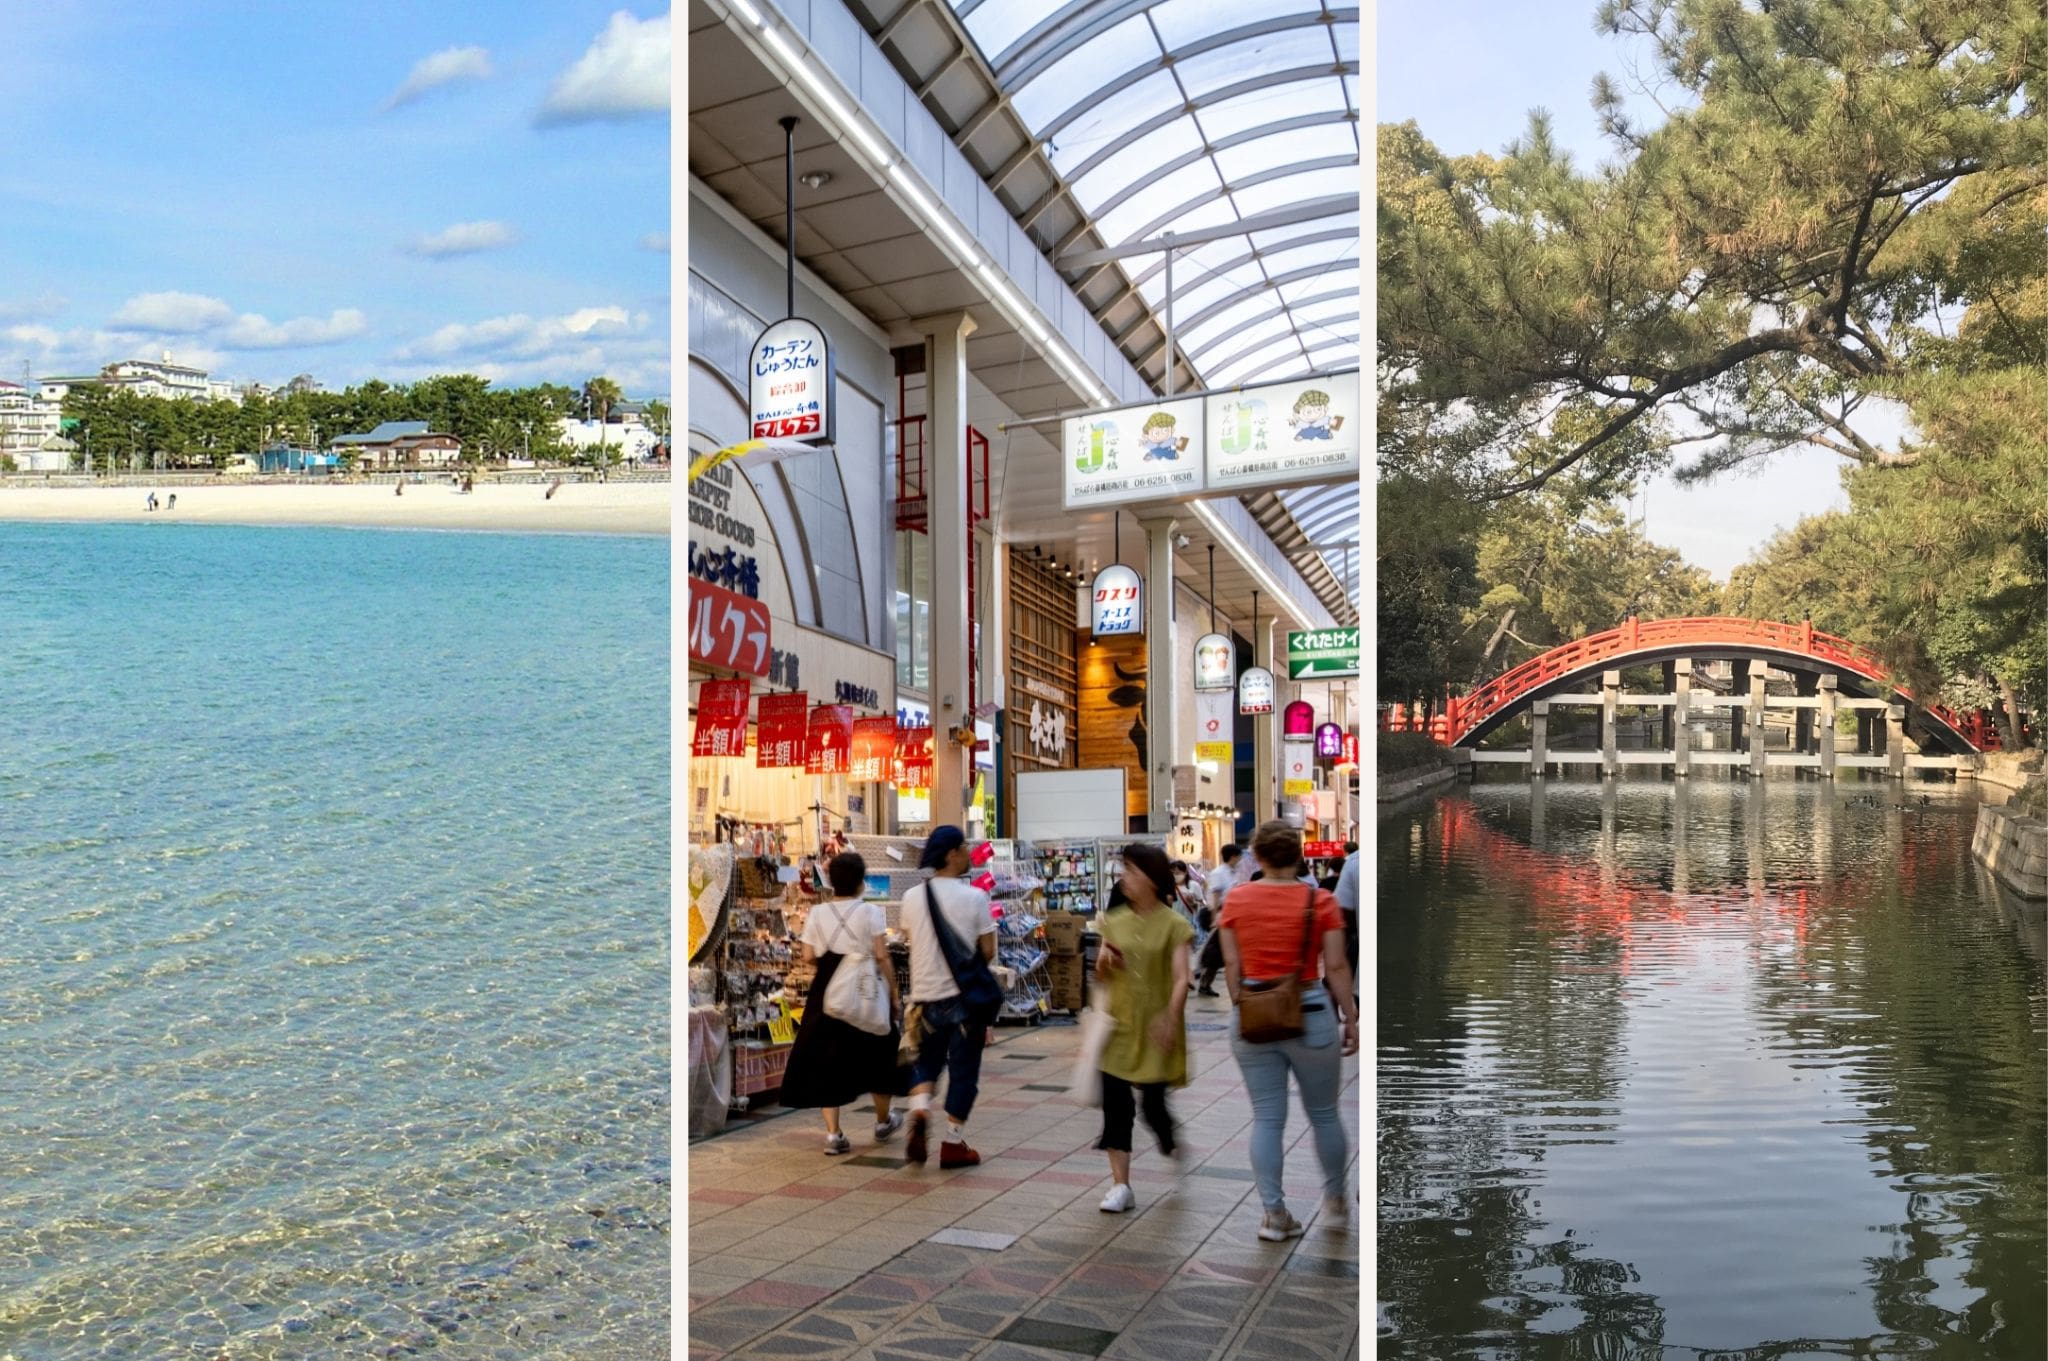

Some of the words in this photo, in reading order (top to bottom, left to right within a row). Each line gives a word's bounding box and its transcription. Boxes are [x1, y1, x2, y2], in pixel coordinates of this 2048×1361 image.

[762, 339, 812, 360] カーテン
[756, 354, 819, 376] じゅうたん
[1095, 587, 1137, 602] クスリ
[1101, 606, 1132, 619] オーエス
[688, 588, 767, 672] ルクラ
[696, 727, 746, 756] 半額!!
[760, 739, 805, 768] 半額!!
[808, 747, 850, 774] 半額!!
